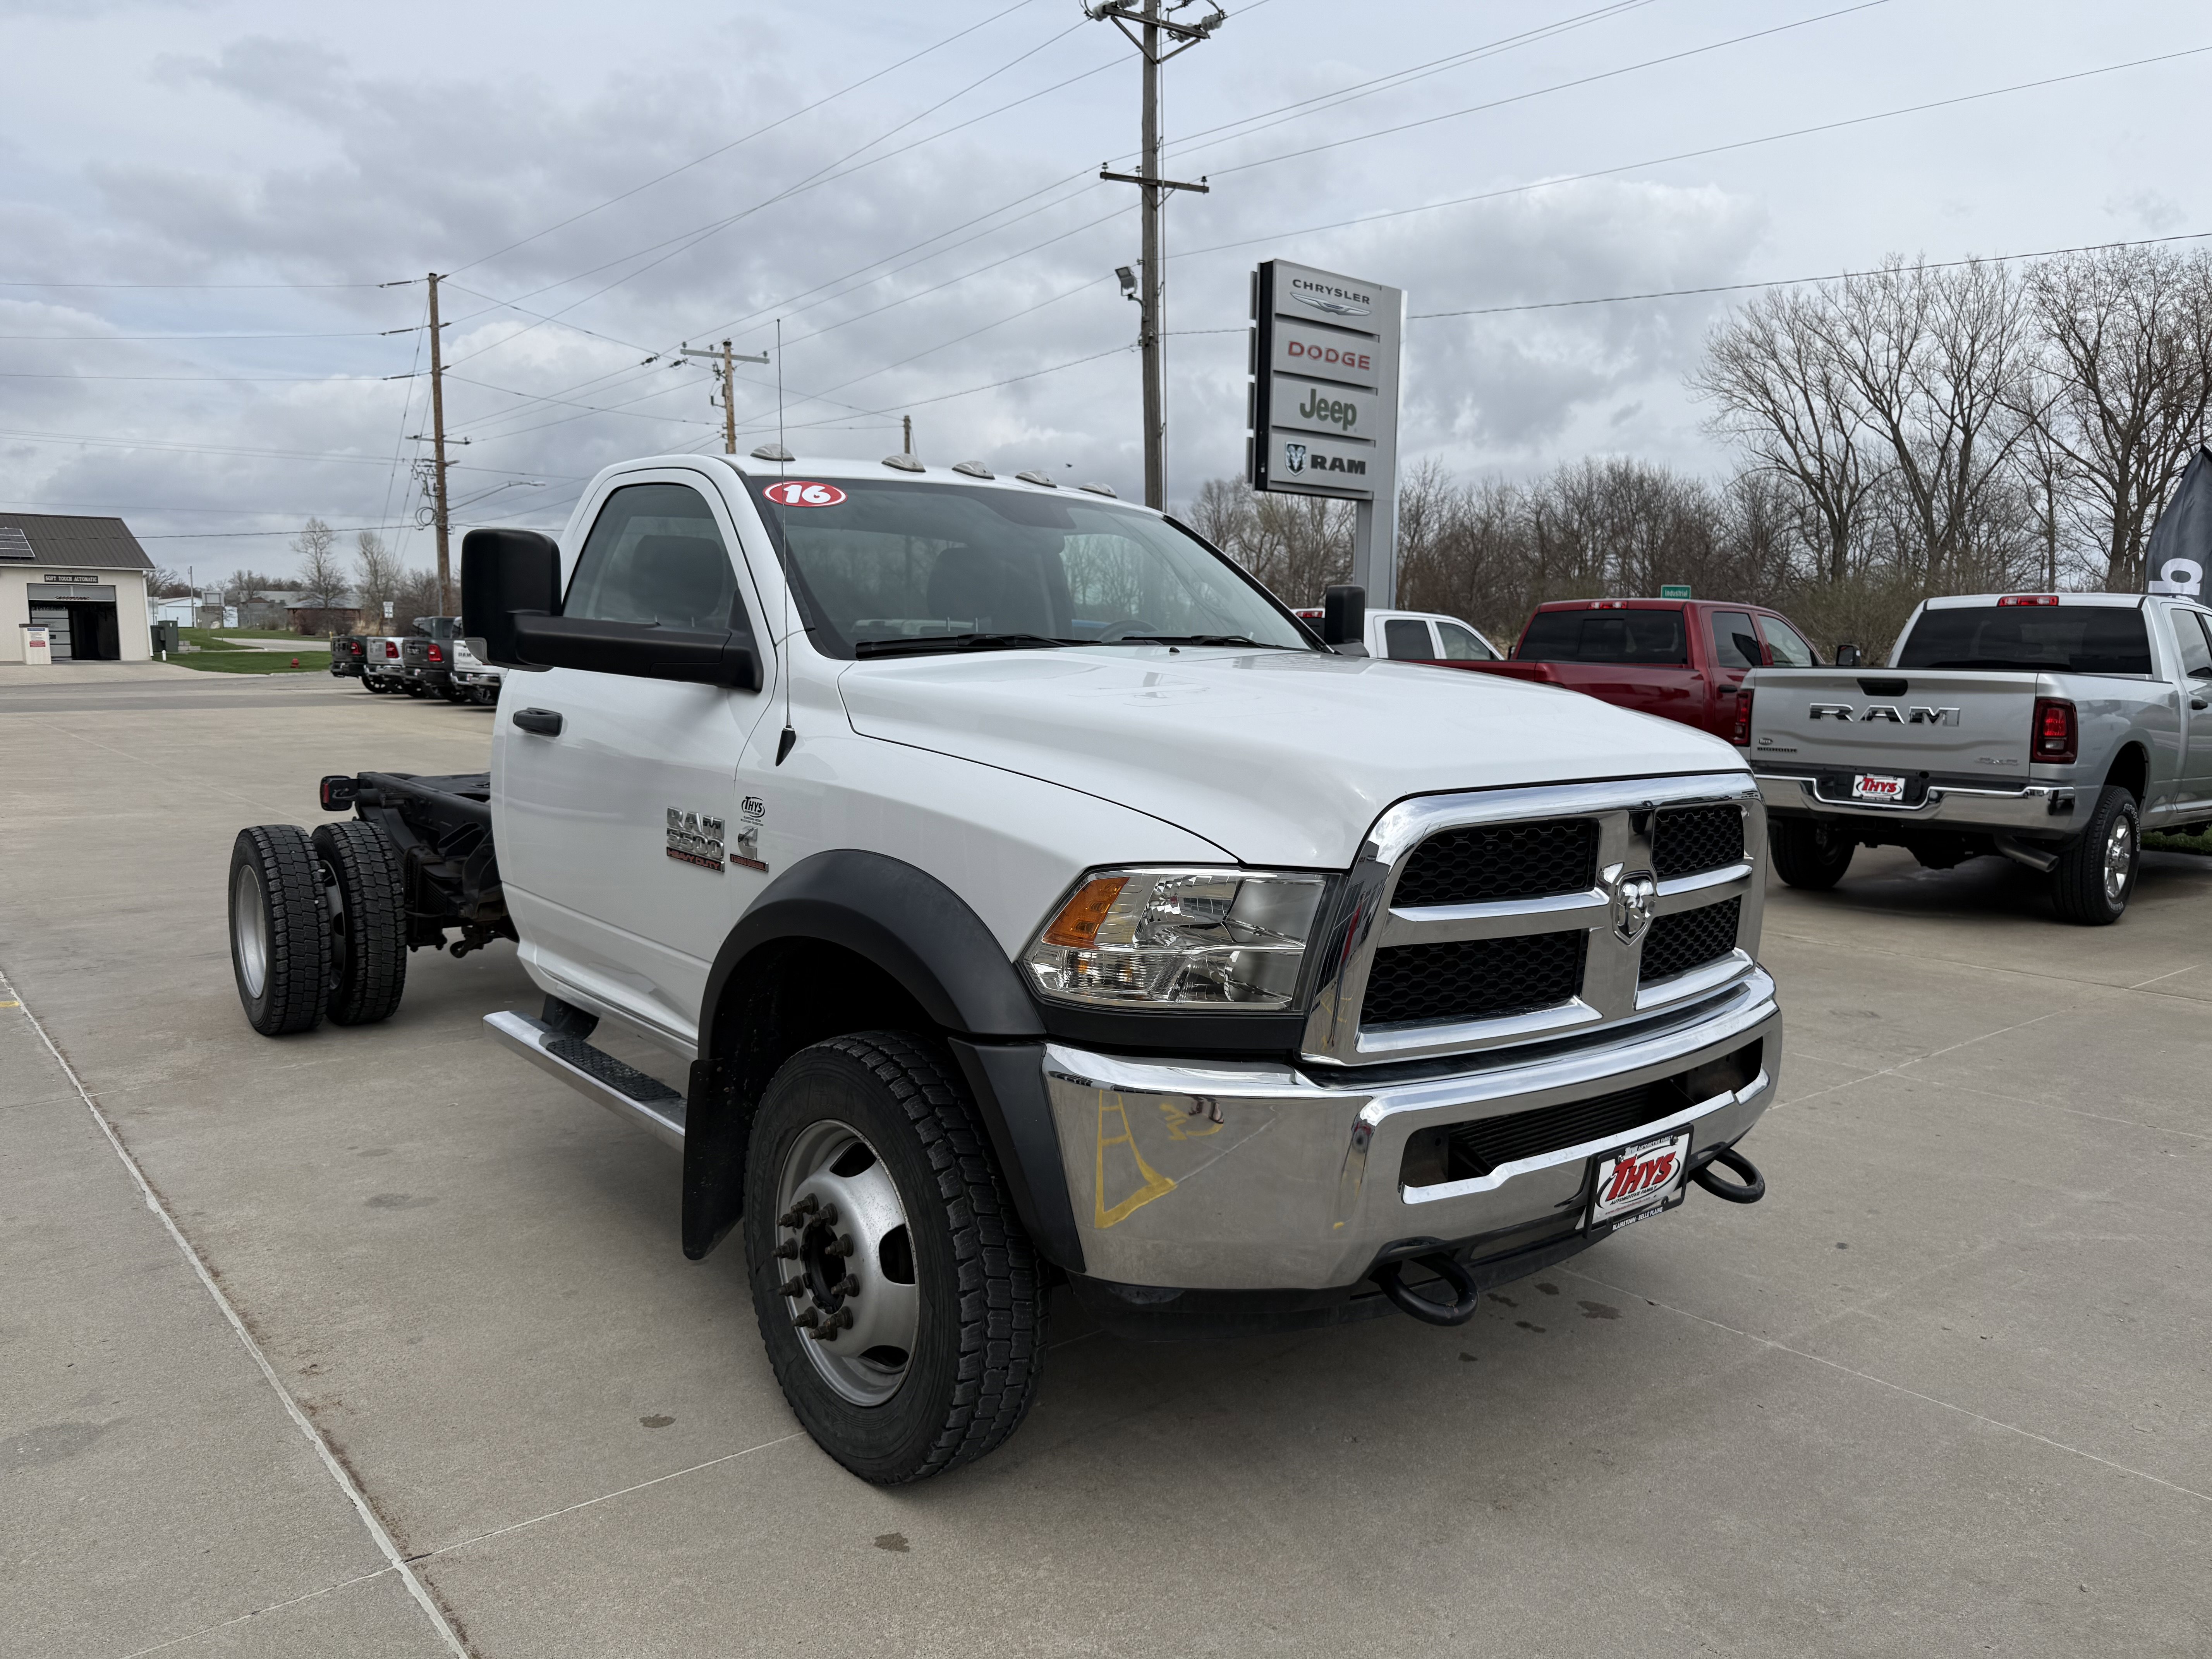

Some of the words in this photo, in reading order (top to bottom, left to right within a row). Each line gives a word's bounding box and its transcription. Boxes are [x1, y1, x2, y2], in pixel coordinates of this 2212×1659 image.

[1292, 279, 1370, 305] CHRYSLER
[1288, 341, 1370, 370] DODGE
[1299, 388, 1357, 431] Jeep
[1310, 454, 1366, 475] RAM
[783, 484, 831, 503] 16
[1809, 703, 1960, 727] RAM
[1862, 777, 1898, 792] THYS
[745, 796, 763, 813] THYS
[667, 807, 725, 839] RAM
[666, 827, 725, 859] 5500
[668, 848, 694, 863] HEAVY
[696, 857, 720, 869] DUTY
[1605, 1151, 1676, 1202] THYS
[1609, 1190, 1640, 1205] AUTOMOTIVE
[1640, 1185, 1657, 1195] FAMILY
[1612, 1216, 1636, 1231] BLAIRSTOWN
[1638, 1211, 1650, 1221] BELLE
[1650, 1207, 1663, 1216] PLAINE
